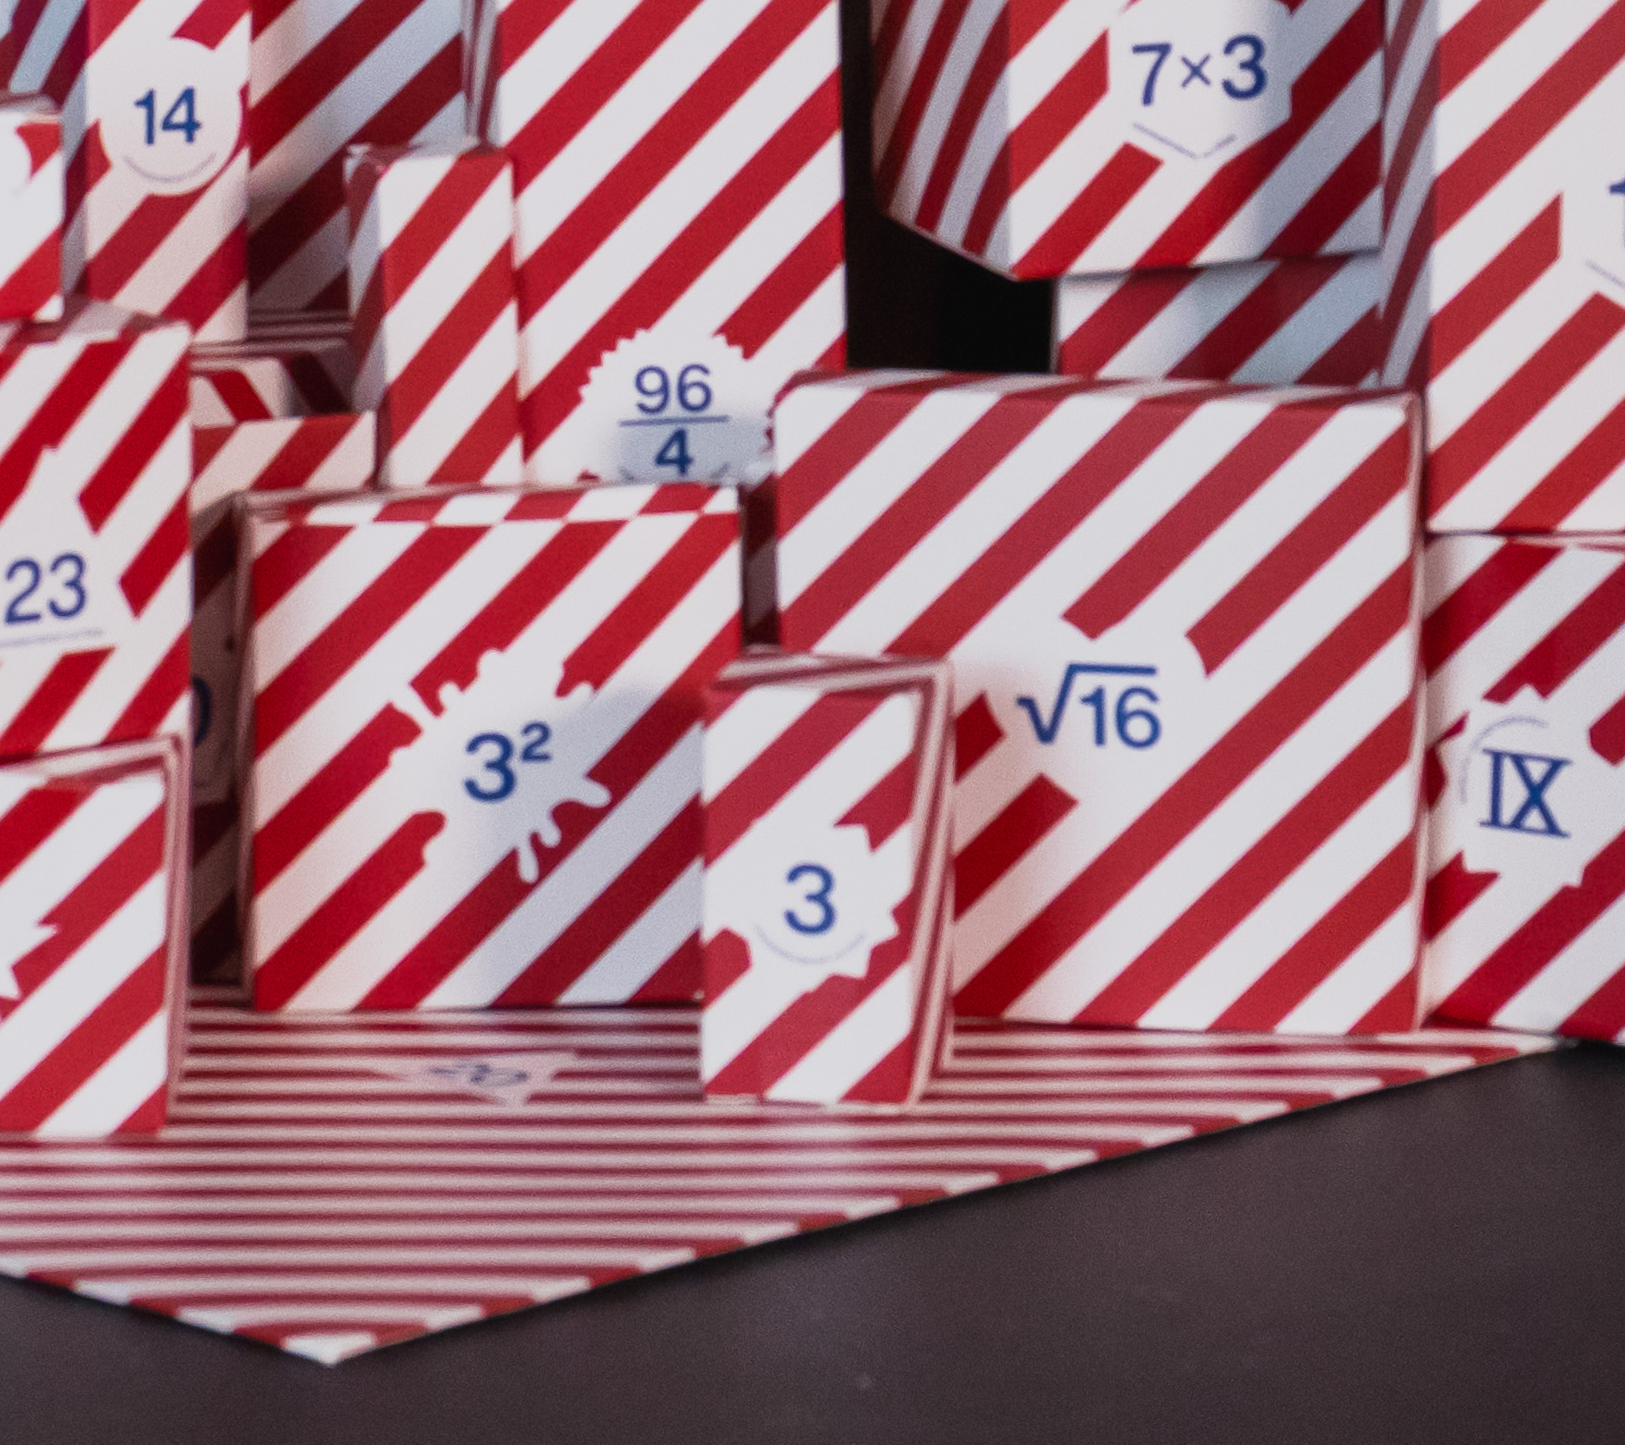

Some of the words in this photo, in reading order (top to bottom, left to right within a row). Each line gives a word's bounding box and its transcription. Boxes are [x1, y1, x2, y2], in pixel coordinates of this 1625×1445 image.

[135, 87, 202, 146] 14
[635, 365, 713, 414] 96
[652, 427, 694, 476] 4
[4, 553, 87, 626] 23
[1479, 748, 1573, 839] IX
[784, 863, 837, 936] 3
